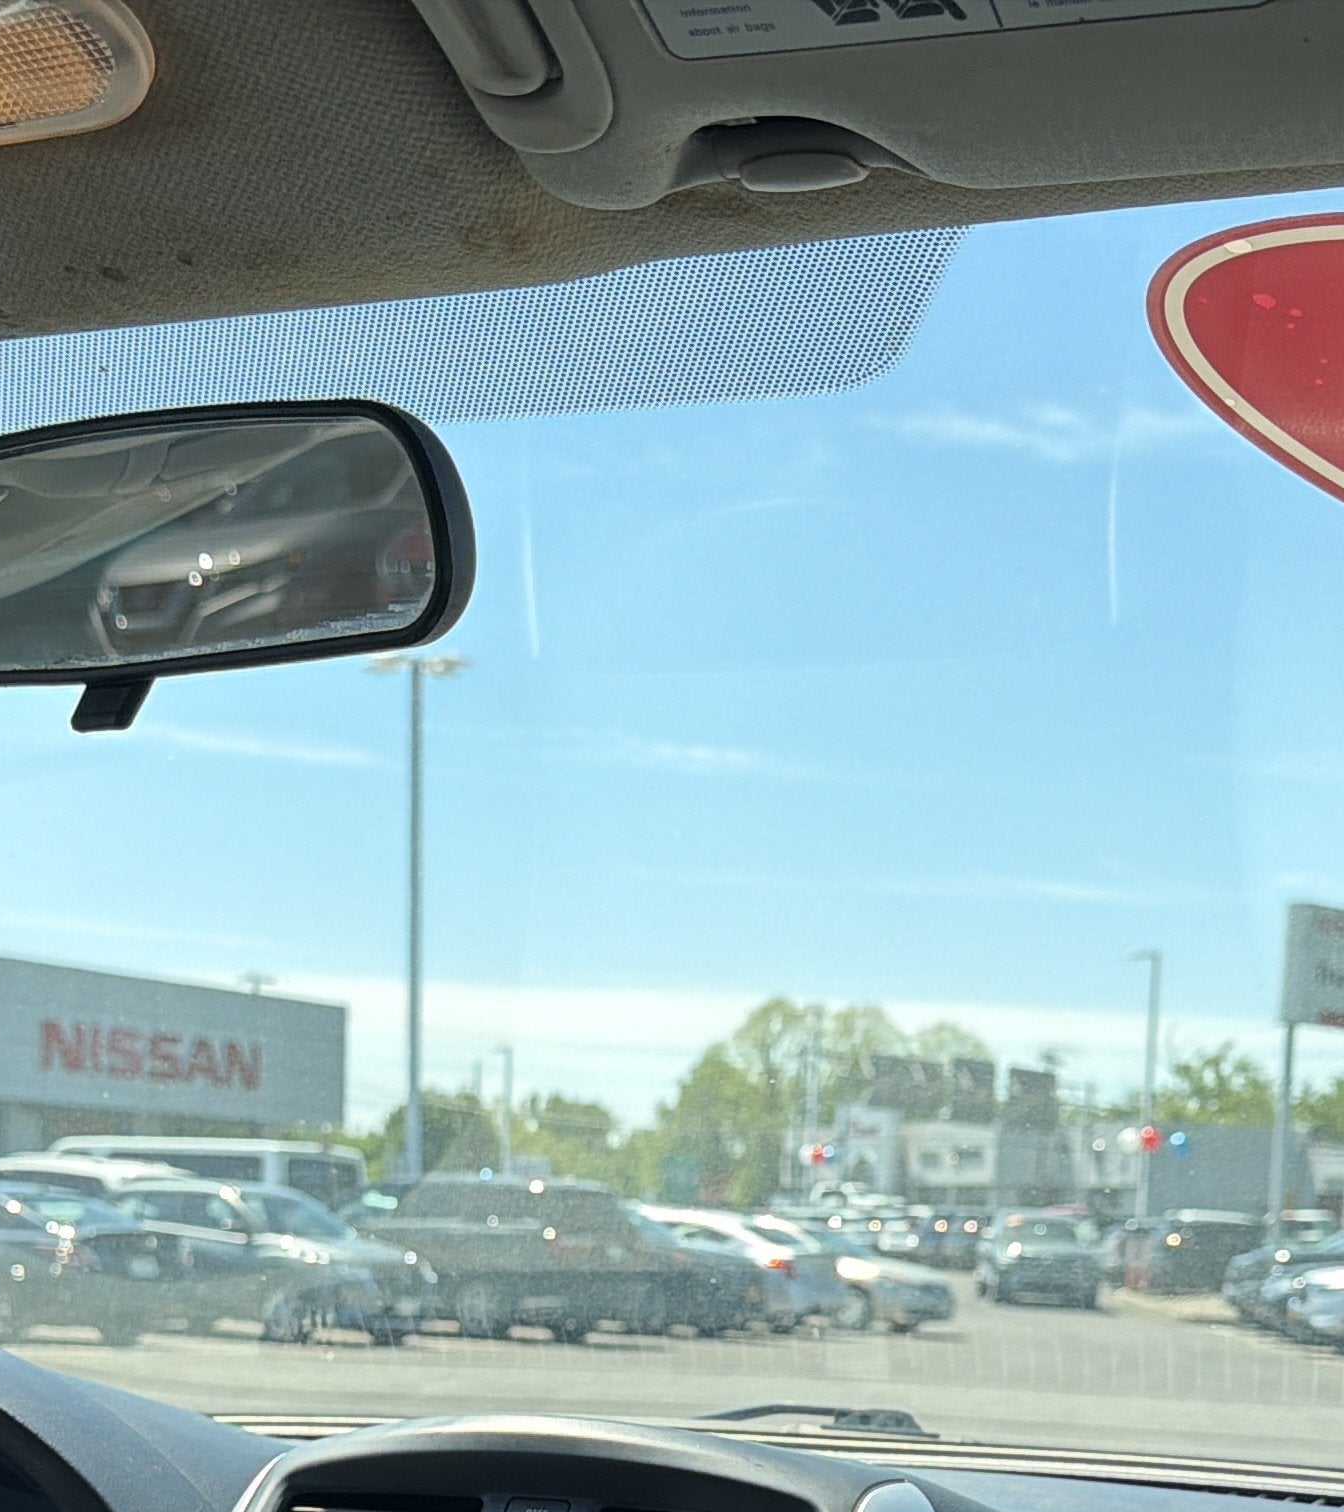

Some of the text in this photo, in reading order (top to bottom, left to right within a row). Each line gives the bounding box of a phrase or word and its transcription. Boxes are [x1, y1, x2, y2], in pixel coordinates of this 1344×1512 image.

[688, 26, 722, 37] about
[744, 22, 776, 33] bags
[39, 1018, 264, 1093] NISSAN
